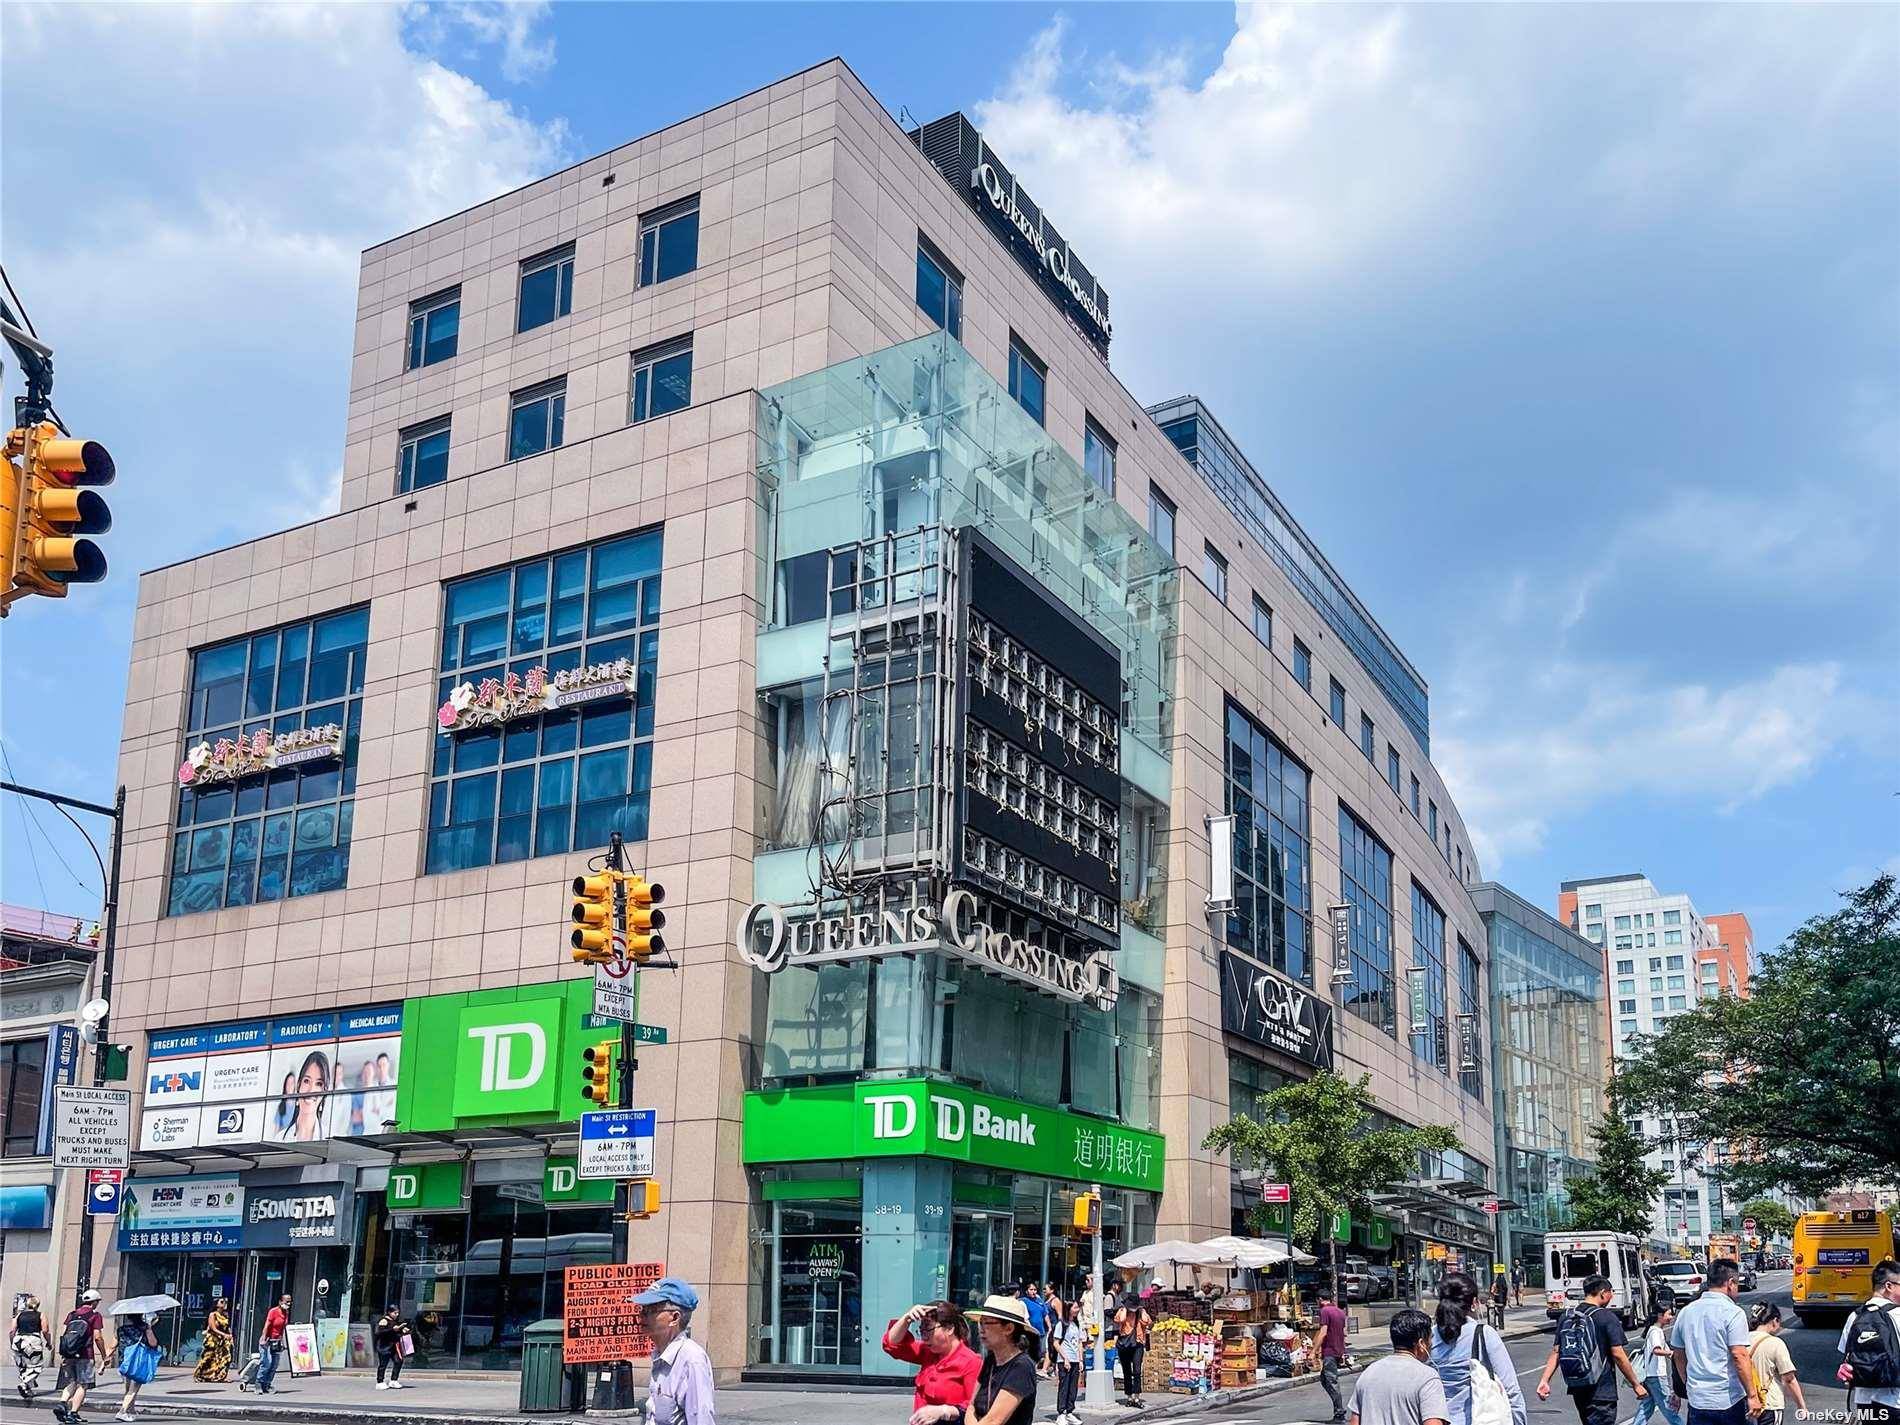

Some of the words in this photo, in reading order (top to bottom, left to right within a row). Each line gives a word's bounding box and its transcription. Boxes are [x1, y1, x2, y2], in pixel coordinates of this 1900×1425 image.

[981, 163, 1046, 257] QUEENS
[1049, 248, 1112, 338] CROSSING
[475, 666, 549, 707] 新木蘭
[558, 682, 624, 705] RESTAURANT
[277, 747, 330, 765] RESTAURANT
[736, 902, 933, 973] QUEENS
[942, 890, 1084, 995] CROSSING
[598, 980, 612, 990] 6AM
[619, 985, 632, 994] 7PM
[604, 994, 625, 1004] EXCEPT
[598, 1005, 610, 1014] MTA
[612, 1008, 630, 1018] BUSES
[590, 1015, 607, 1027] Main
[153, 1039, 178, 1050] URGENT
[180, 1037, 198, 1047] CARE
[214, 1030, 259, 1044] LABORATORY
[281, 1024, 323, 1036] RADIOLOGY
[350, 1018, 375, 1029] MEDICAL
[376, 1014, 400, 1026] BEAUTY
[642, 1027, 652, 1039] 39
[468, 1022, 546, 1092] TD
[214, 1068, 239, 1077] URGENT
[242, 1066, 259, 1074] CARE
[74, 1106, 90, 1114] 6AM
[98, 1107, 113, 1115] 7PM
[864, 1095, 917, 1138] TD
[85, 1118, 118, 1126] VEHICLES
[612, 1113, 646, 1121] RESTRICTION
[930, 1095, 965, 1142] TD
[972, 1104, 1036, 1146] Bank
[58, 1136, 85, 1144] TRUCKS
[598, 1142, 612, 1151] 6AM
[621, 1142, 637, 1150] 7PM
[61, 1156, 78, 1164] NEXT
[81, 1156, 100, 1164] RIGHT
[548, 1166, 576, 1192] TD
[391, 1175, 417, 1199] TD
[259, 1198, 303, 1219] SONG
[304, 1195, 335, 1218] TEA
[810, 1244, 837, 1256] ATM
[810, 1259, 838, 1267] ALWAYS
[570, 1268, 612, 1280] PUBLIC
[617, 1265, 660, 1277] NOTICE
[809, 1267, 832, 1276] OPEN
[573, 1282, 604, 1290] ROAD
[567, 1297, 599, 1306] AUGUST
[568, 1309, 587, 1317] FROM
[590, 1307, 608, 1315] 10:00
[570, 1319, 584, 1328] 2-3
[586, 1317, 615, 1327] NIGHTS
[618, 1316, 634, 1324] PER
[580, 1327, 601, 1337] WILL
[603, 1327, 614, 1335] BE
[616, 1325, 640, 1334] CLOS
[567, 1346, 587, 1355] MAIN
